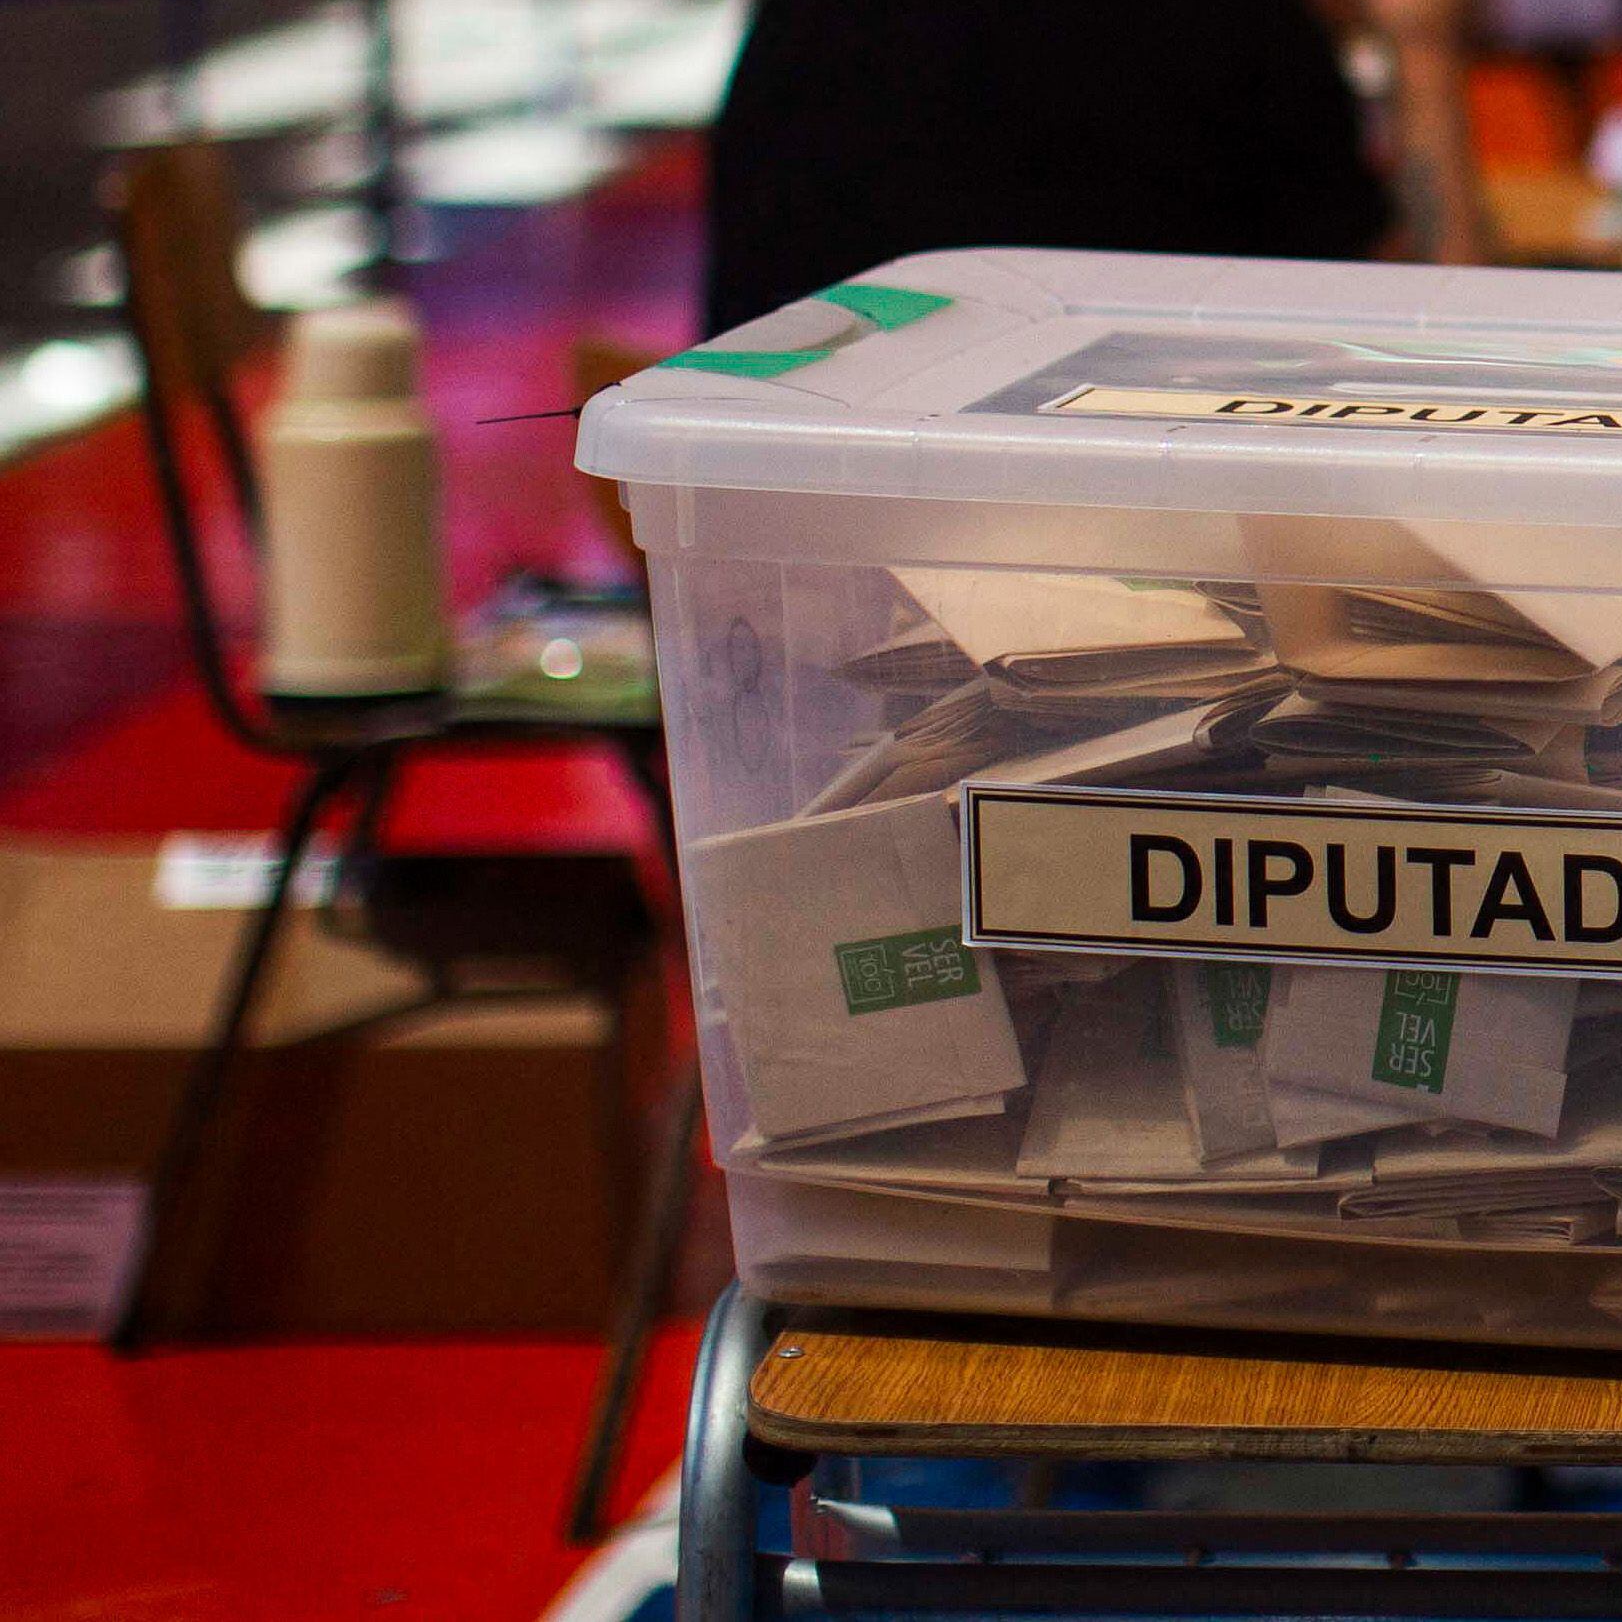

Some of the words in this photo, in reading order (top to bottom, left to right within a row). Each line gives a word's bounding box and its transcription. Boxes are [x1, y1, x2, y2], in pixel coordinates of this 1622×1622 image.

[901, 942, 933, 989] VEL
[929, 938, 965, 984] SER
[1396, 1011, 1437, 1048] VEL
[1389, 1043, 1436, 1078] SER
